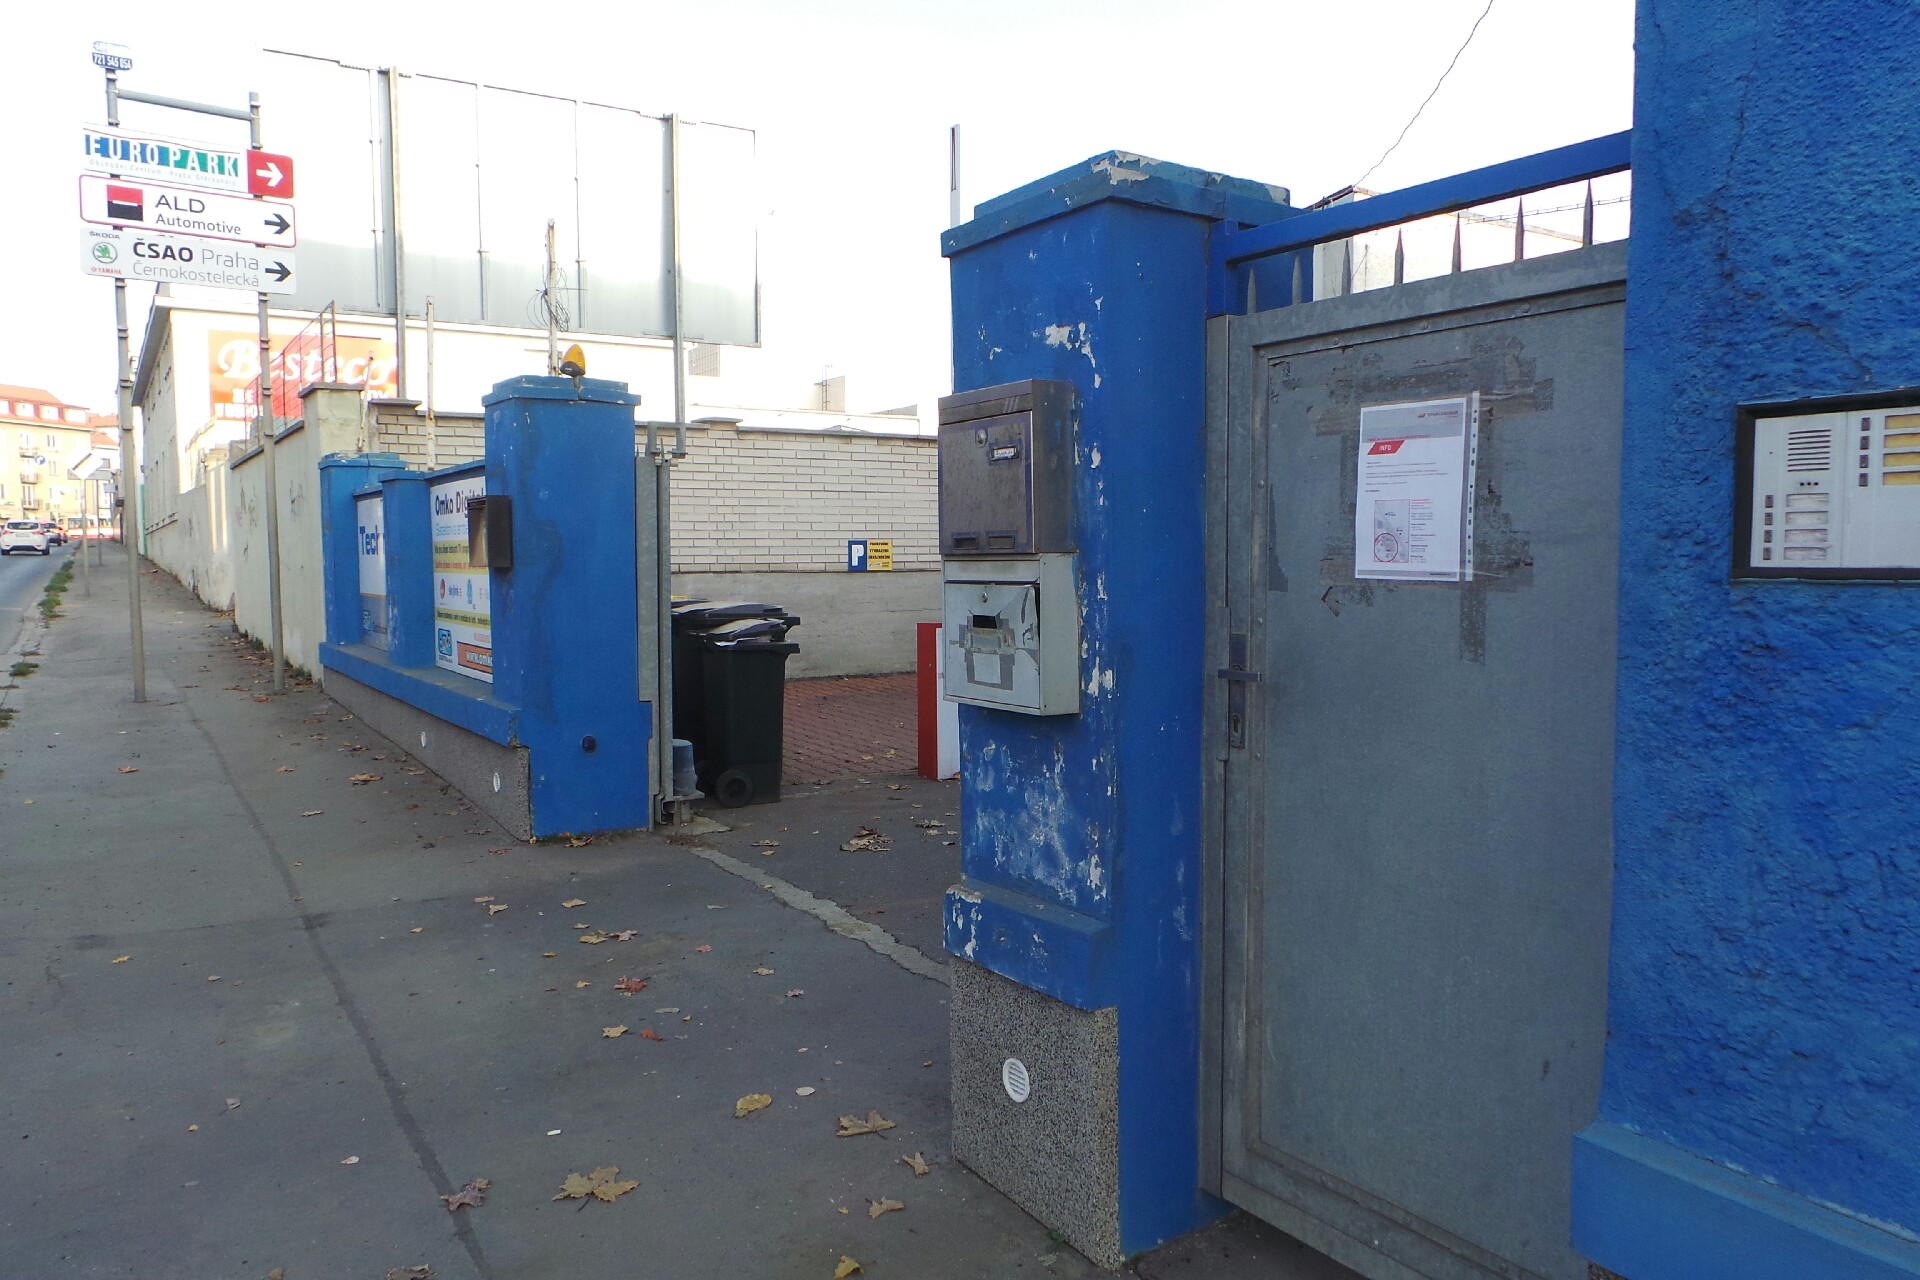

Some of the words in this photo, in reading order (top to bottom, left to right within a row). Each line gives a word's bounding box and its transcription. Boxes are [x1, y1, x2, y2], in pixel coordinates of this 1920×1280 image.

[93, 53, 106, 66] 721
[107, 56, 119, 68] 545
[88, 134, 239, 178] EUROPARK
[155, 194, 206, 214] ALD
[155, 213, 242, 235] Automotive
[132, 237, 194, 263] ČSAO
[201, 248, 260, 271] Praha
[132, 259, 260, 287] Černokostelecká
[852, 544, 864, 566] P
